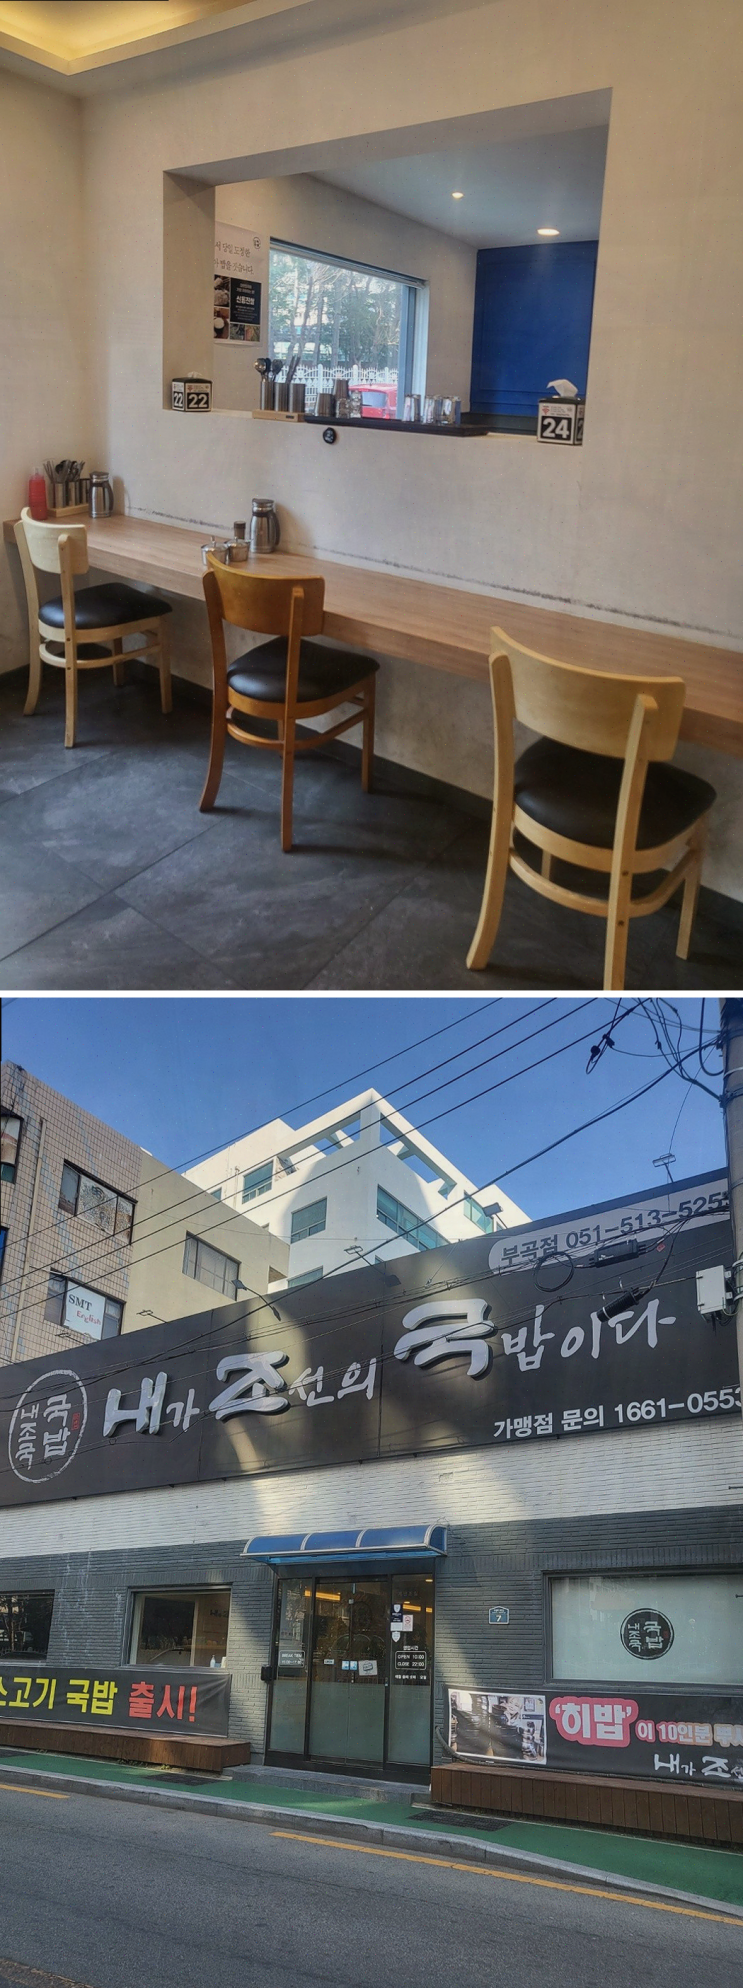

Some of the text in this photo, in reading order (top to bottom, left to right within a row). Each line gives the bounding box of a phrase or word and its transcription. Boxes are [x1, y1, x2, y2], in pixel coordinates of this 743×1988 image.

[174, 392, 183, 407] 22
[189, 393, 208, 408] 22
[542, 418, 569, 439] 24
[501, 1234, 558, 1266] 부곡점
[68, 1293, 93, 1311] SMT
[76, 1310, 101, 1326] English
[103, 1298, 677, 1437] 내가 조선의 국밥이다
[43, 1393, 72, 1459] 국밥
[493, 1412, 553, 1439] 가맹점
[561, 1405, 604, 1431] 문의
[495, 1614, 502, 1622] 7
[643, 1620, 664, 1649] 국밥
[66, 1679, 118, 1716] 국밥
[128, 1681, 198, 1722] 출시!
[658, 1724, 711, 1746] 10인분
[654, 1753, 696, 1776] 내가
